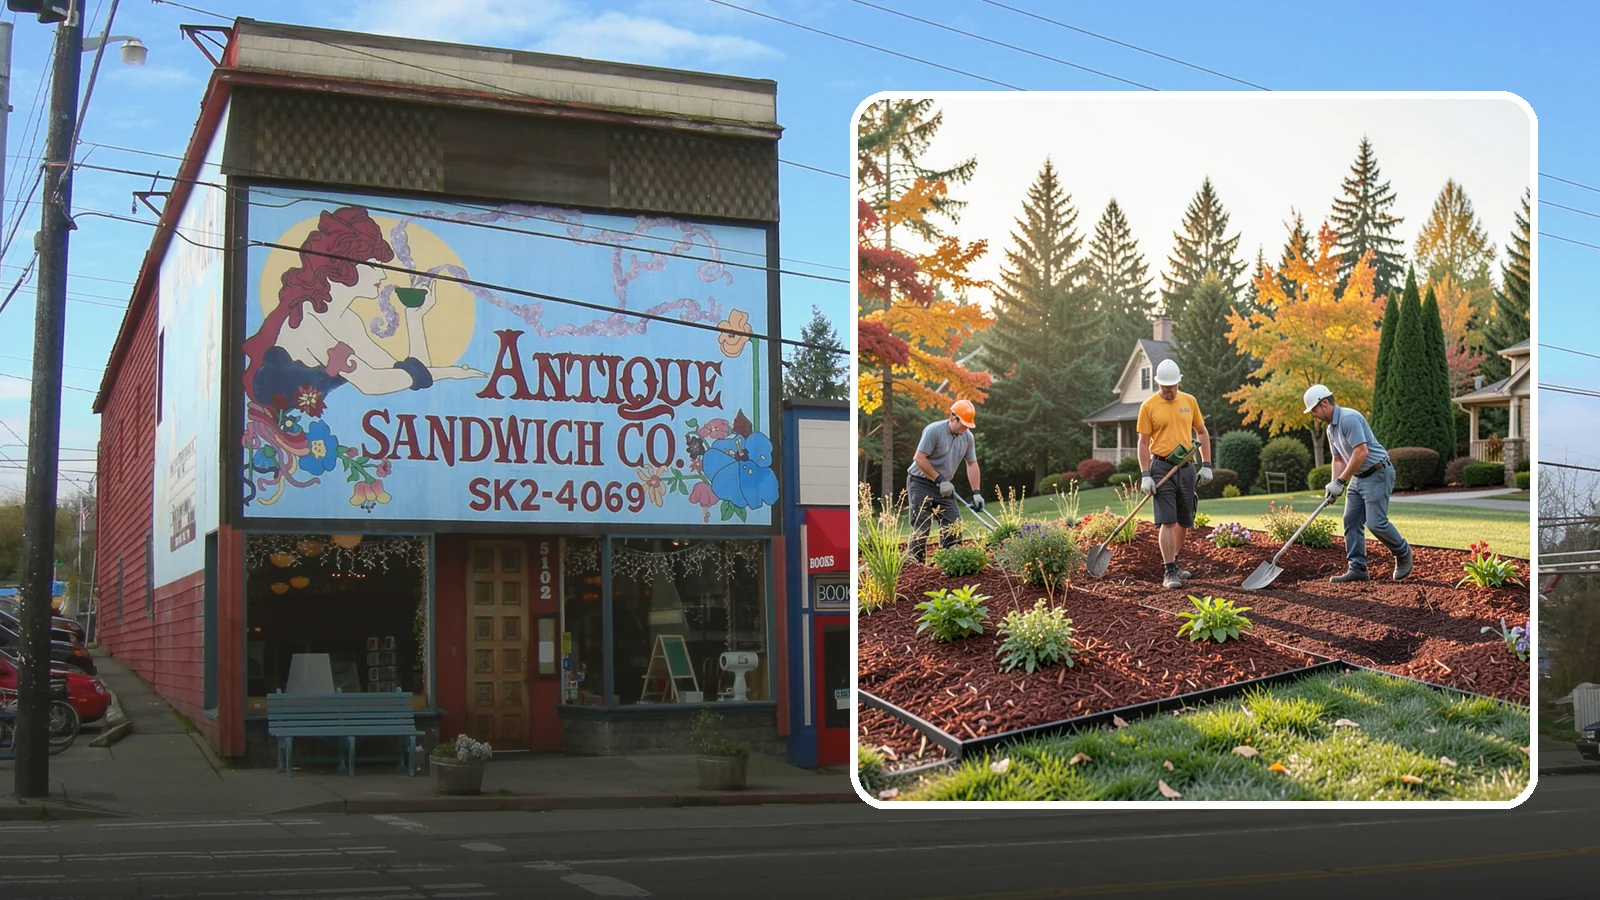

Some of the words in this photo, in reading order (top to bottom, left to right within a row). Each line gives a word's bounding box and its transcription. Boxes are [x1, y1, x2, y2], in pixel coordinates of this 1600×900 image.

[476, 329, 723, 420] ANTIQUE
[362, 409, 604, 467] SANDWICH
[617, 420, 684, 469] CO.
[469, 477, 646, 512] SK2-4069
[539, 541, 551, 599] 5102
[809, 555, 834, 568] BOOKS
